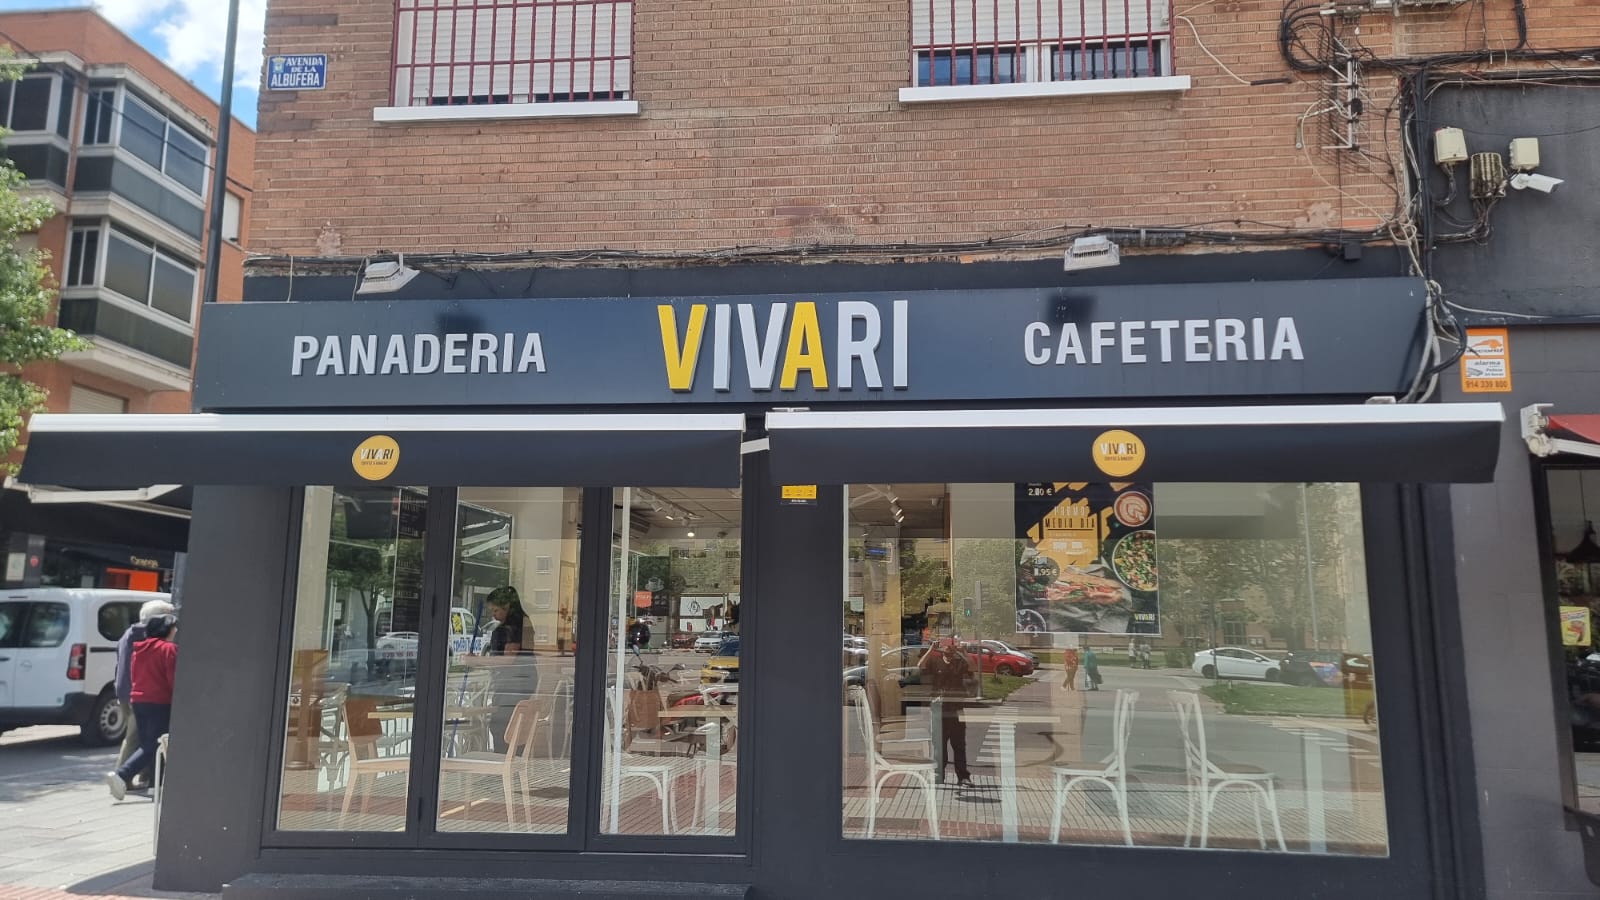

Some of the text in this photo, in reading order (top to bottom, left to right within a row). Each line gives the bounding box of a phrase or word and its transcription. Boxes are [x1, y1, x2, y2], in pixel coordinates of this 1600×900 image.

[285, 57, 324, 66] AVENIDA
[271, 72, 320, 87] ALBUFERA
[657, 300, 909, 392] VIVARI
[1024, 317, 1305, 366] CAFETERIA
[291, 332, 547, 376] PANADERIA
[361, 448, 394, 460] VIVARI
[1101, 442, 1138, 455] VIVARI
